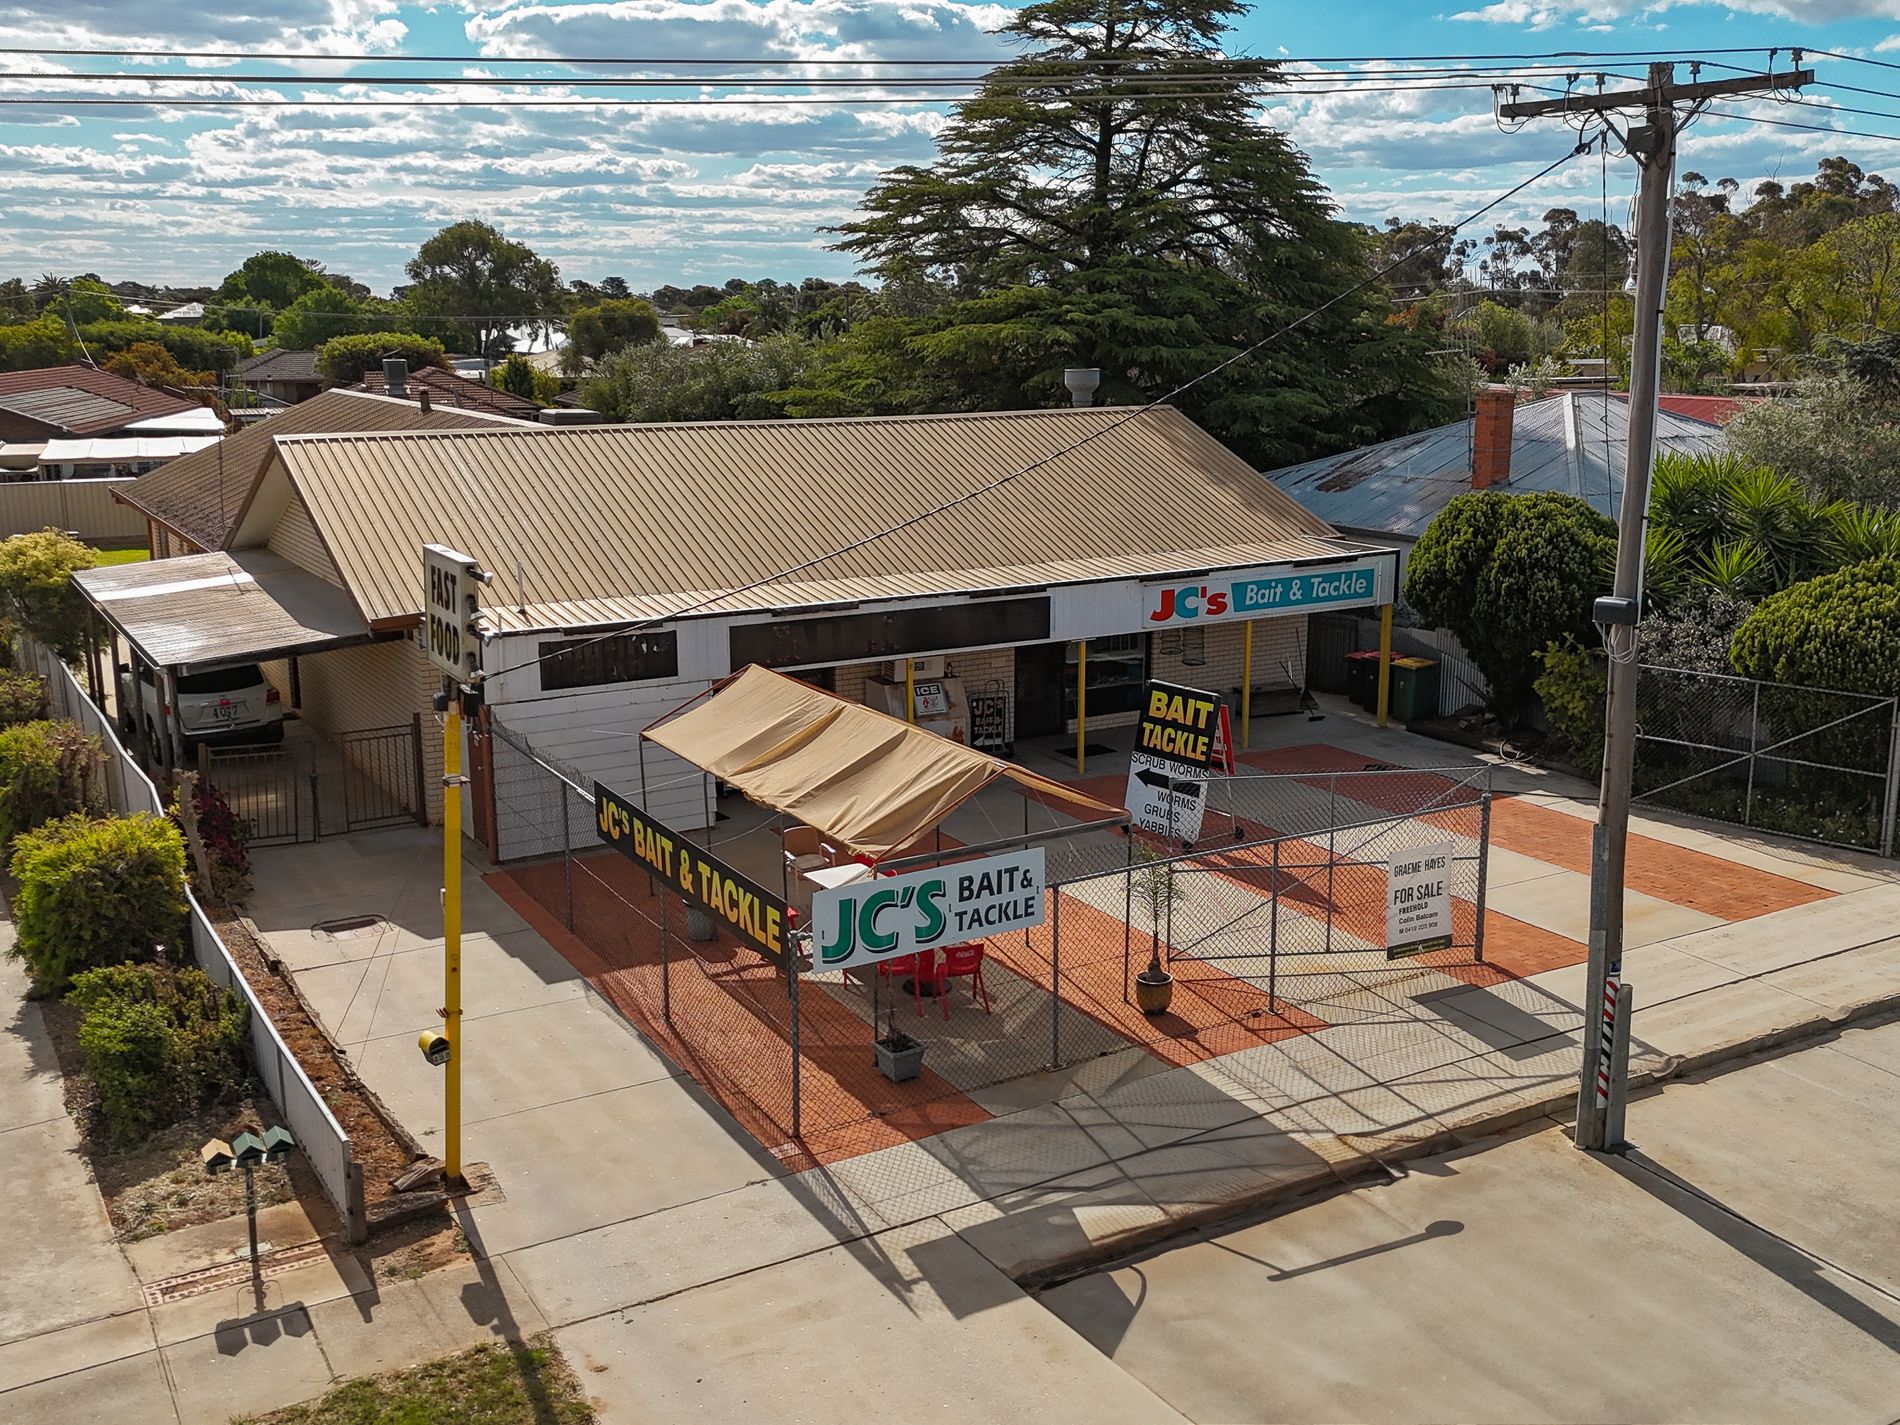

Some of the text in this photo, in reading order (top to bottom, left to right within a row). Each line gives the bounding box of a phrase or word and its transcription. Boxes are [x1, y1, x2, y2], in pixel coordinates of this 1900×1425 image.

[430, 564, 457, 615] FAST
[1150, 573, 1366, 622] JC's Bait & Tackle
[430, 612, 460, 666] FOOD
[916, 686, 939, 696] ICE
[1148, 690, 1214, 729] BAIT
[974, 725, 1003, 735] TACKLE
[1142, 721, 1209, 762] TACKLE
[1131, 752, 1210, 779] SCRUB WORMS
[1157, 790, 1197, 811] WORMS
[1394, 856, 1446, 878] GRAEME HAYES
[633, 816, 673, 878] BAIT
[679, 849, 694, 894] &
[697, 860, 781, 955] TACKLE
[1393, 880, 1444, 906] FOR SALE
[821, 880, 947, 964] JC'S
[954, 895, 1036, 932] TACKLE
[1398, 901, 1429, 915] FREEHOLD
[1398, 917, 1415, 925] Colin
